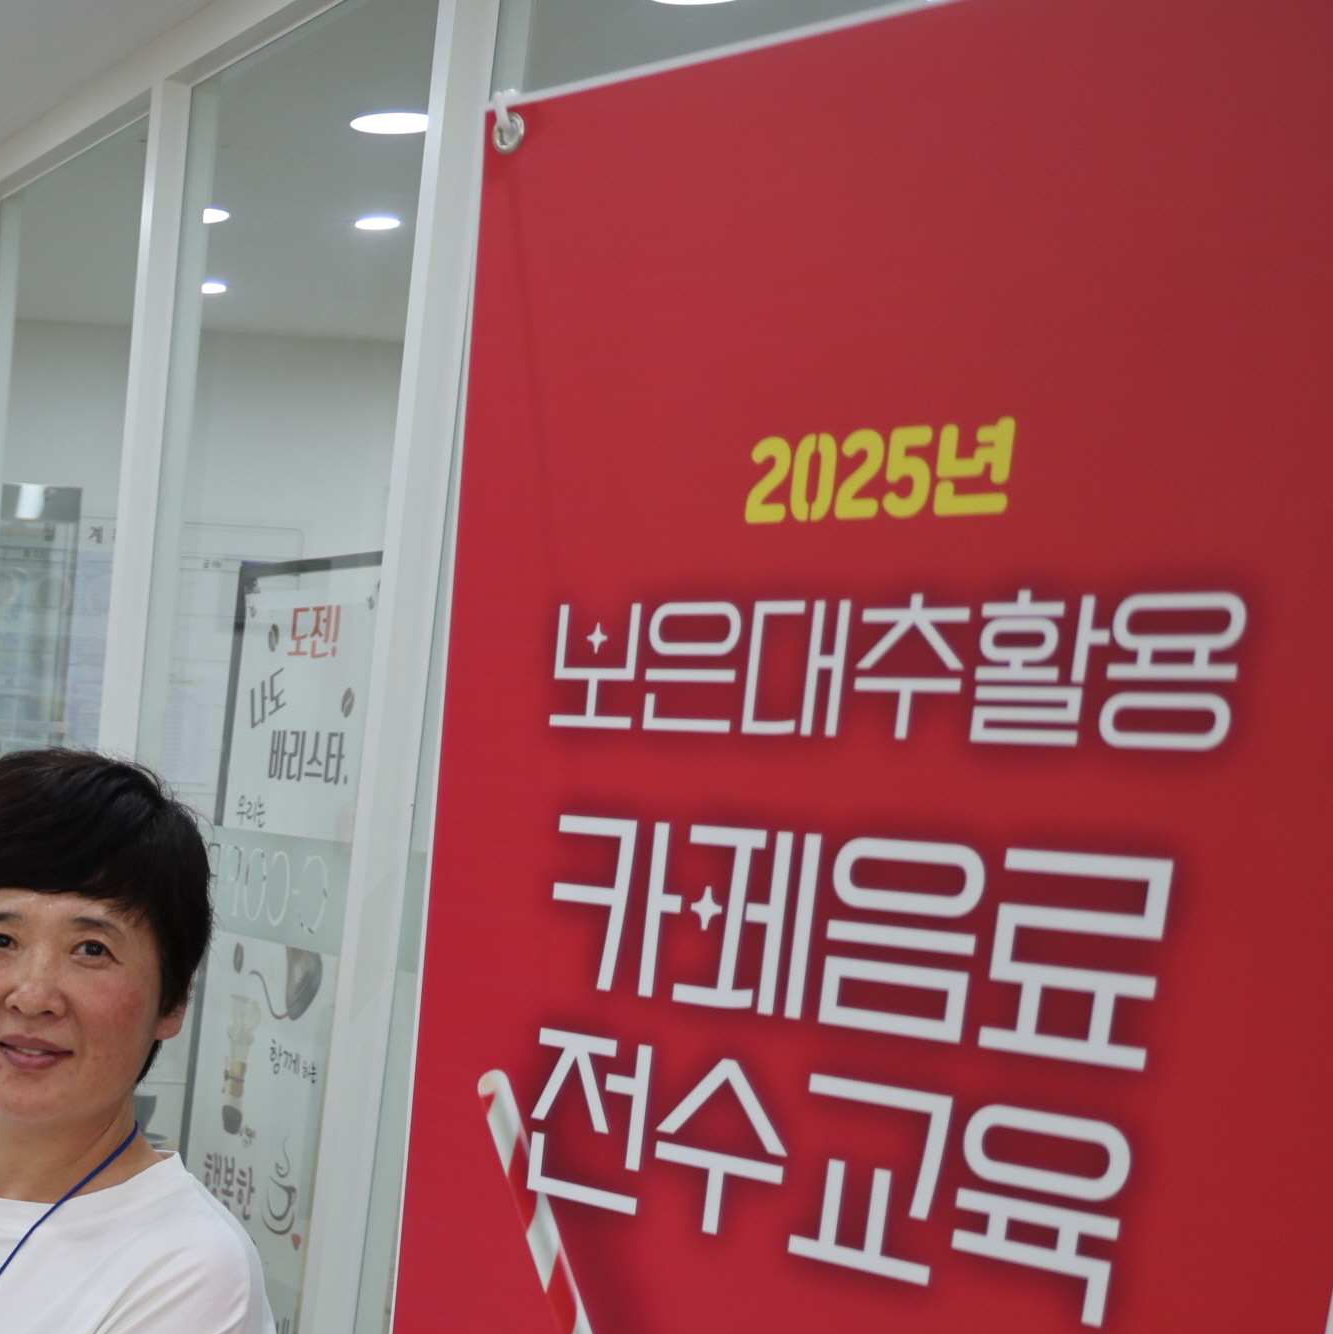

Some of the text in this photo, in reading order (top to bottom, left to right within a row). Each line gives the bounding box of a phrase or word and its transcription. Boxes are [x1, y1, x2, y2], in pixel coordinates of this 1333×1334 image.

[745, 417, 1015, 524] 2025년
[89, 525, 103, 543] 계
[287, 605, 341, 658] 도전!
[549, 590, 1247, 750] 보은대추활용
[250, 668, 286, 728] 나도
[237, 795, 265, 828] 우리는
[552, 815, 1173, 1070] 카페음료
[527, 1027, 1130, 1327] 전수교육
